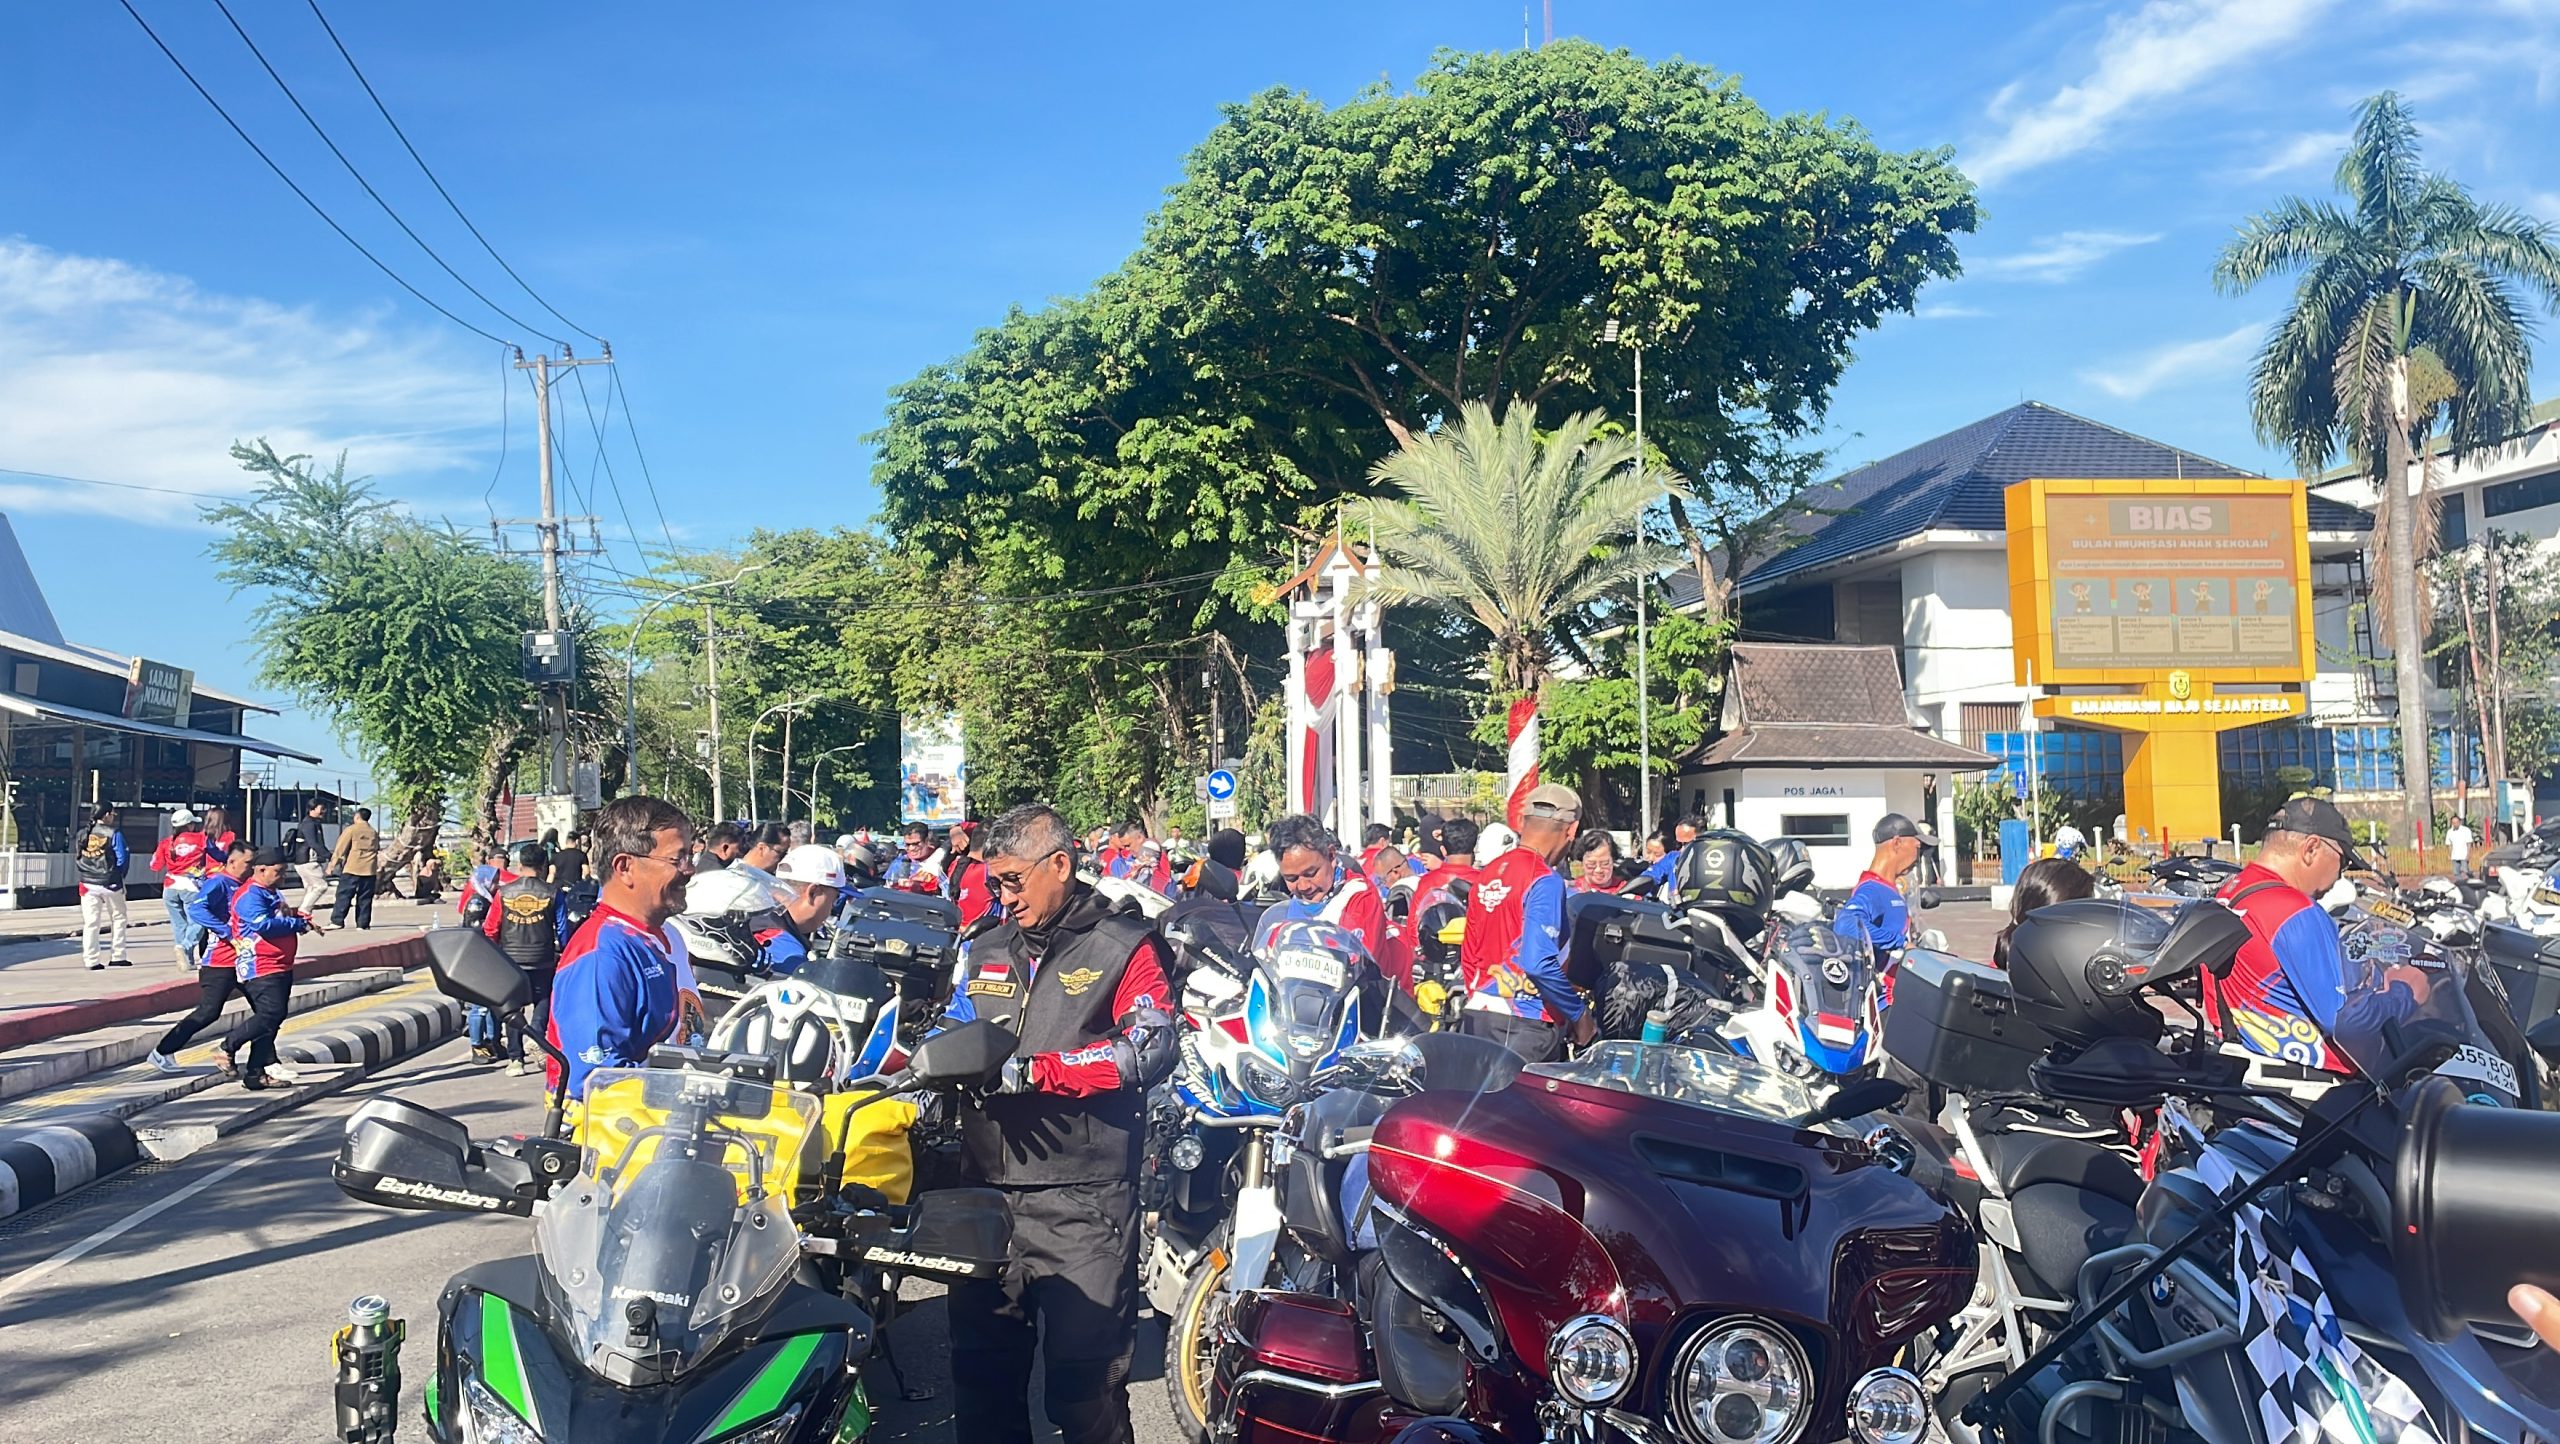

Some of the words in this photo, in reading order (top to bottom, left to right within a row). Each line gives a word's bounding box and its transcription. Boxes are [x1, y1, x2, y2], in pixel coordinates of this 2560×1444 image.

[2128, 506, 2213, 531] BIAS
[2072, 539, 2112, 549] BULAN
[2114, 539, 2177, 549] IMUNISASI
[2178, 539, 2212, 548] ANAK
[2215, 538, 2269, 548] SEKOLAH
[148, 669, 178, 691] SARABA
[143, 686, 178, 708] NYAMAN
[1784, 787, 1805, 796] POS
[1810, 786, 1836, 796] JAGA
[1839, 787, 1844, 795] 1
[2488, 1057, 2516, 1081] BOI
[2486, 1071, 2517, 1093] 04.26
[375, 1176, 500, 1209] Barkbusters
[864, 1246, 976, 1275] Barkbusters
[610, 1285, 691, 1308] Kawasaki
